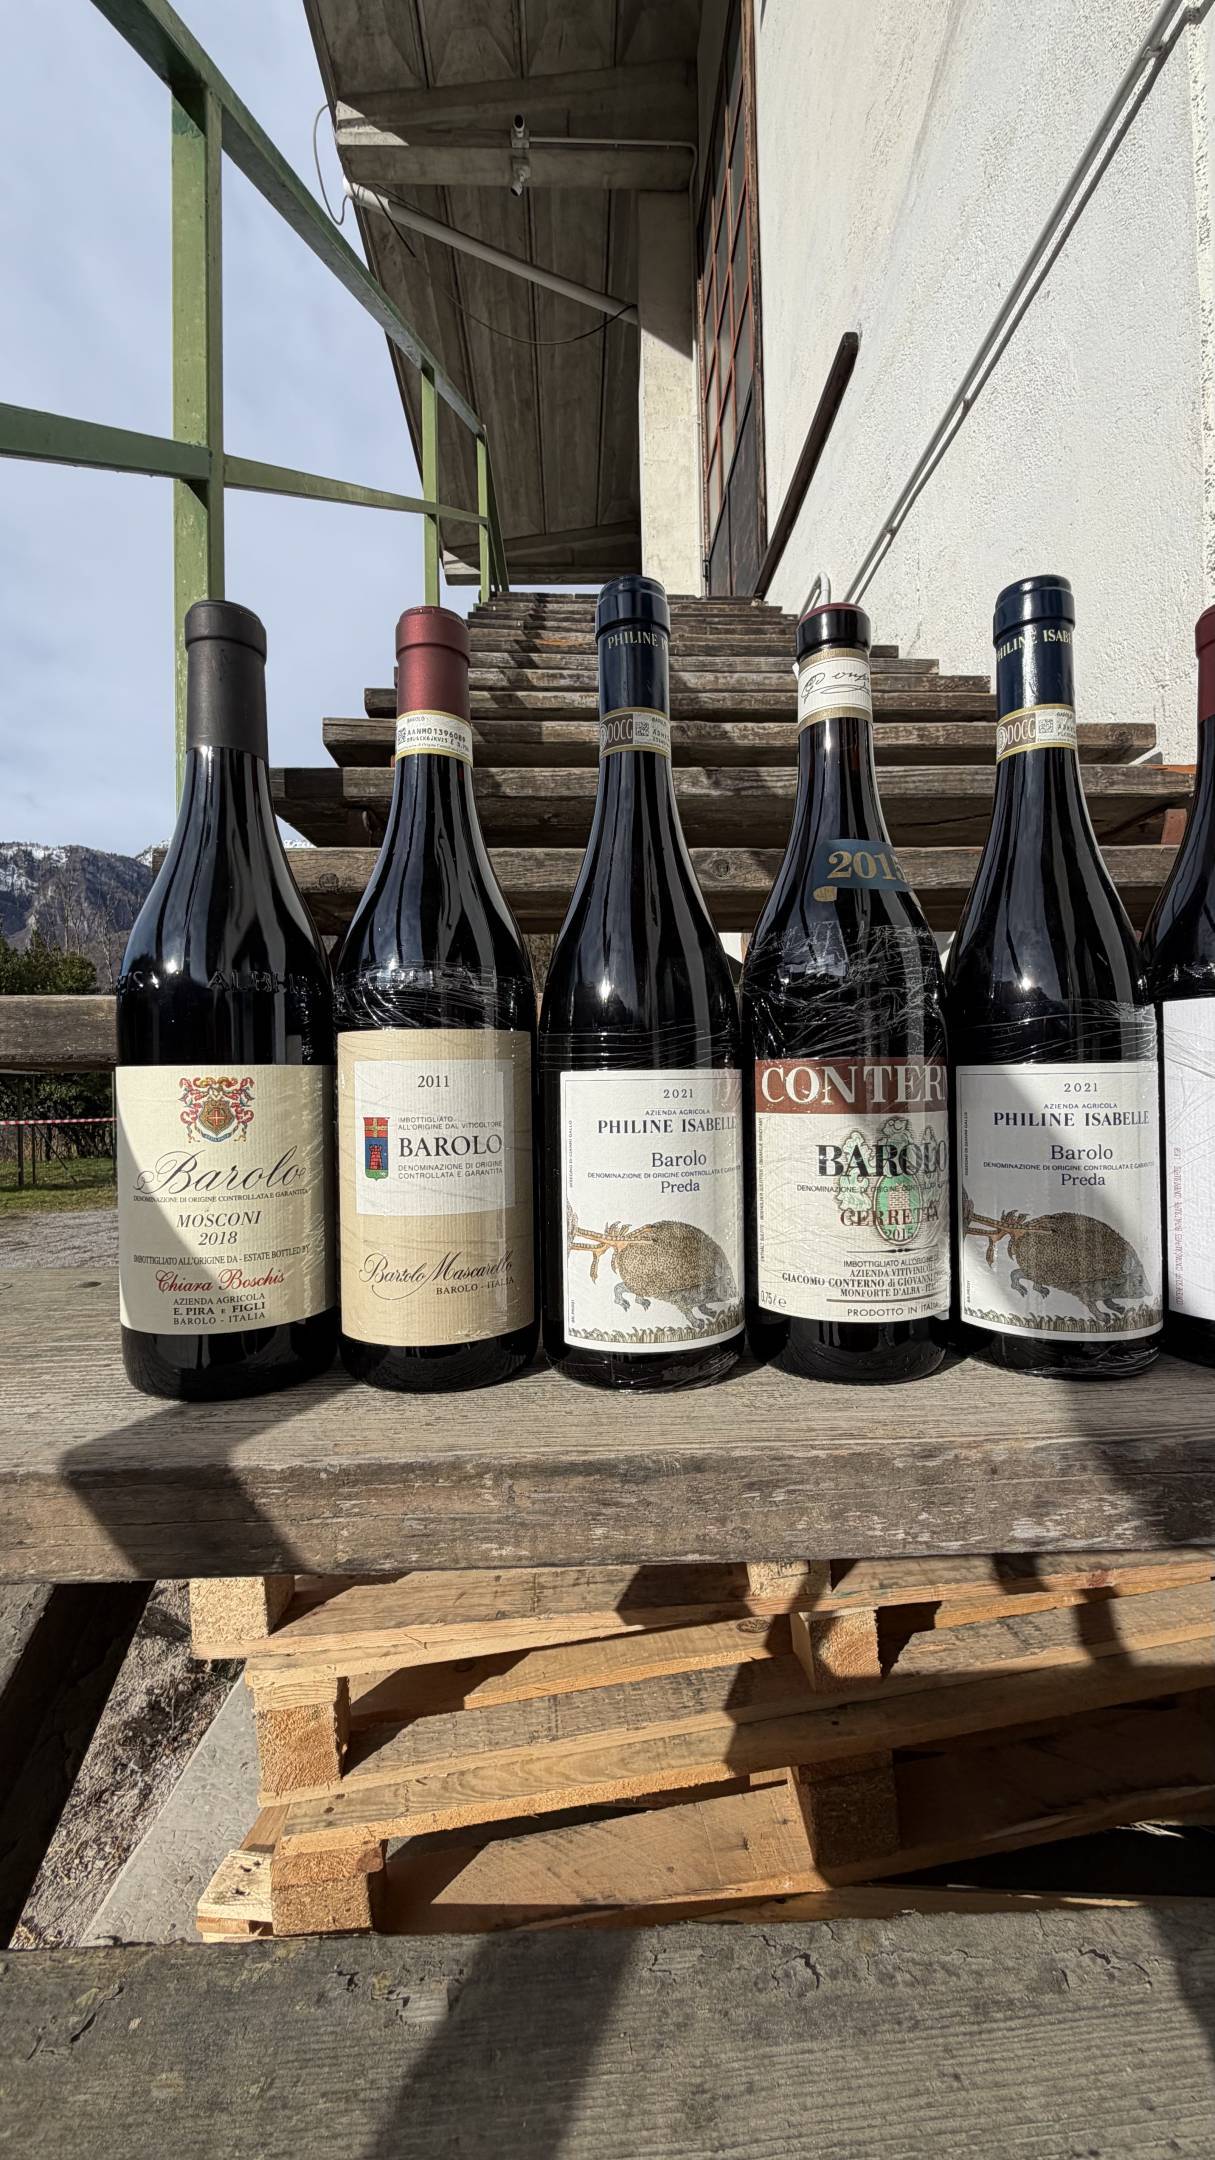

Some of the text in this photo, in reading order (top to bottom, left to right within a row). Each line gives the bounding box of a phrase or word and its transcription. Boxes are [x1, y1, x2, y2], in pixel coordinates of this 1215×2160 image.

[608, 631, 659, 649] PHILINE
[1007, 718, 1036, 745] DOCG
[417, 1075, 450, 1088] 2011
[1063, 1082, 1097, 1093] 2021
[663, 1088, 693, 1099] 2021
[461, 1121, 502, 1129] VITICOLTORE
[597, 1115, 736, 1134] PHILINE ISABELLE
[993, 1110, 1150, 1127] PHILINE ISABELLE
[398, 1133, 503, 1157] BAROLO
[1050, 1143, 1113, 1160] Barolo
[398, 1163, 463, 1172] DENOMINAZIONE
[475, 1160, 503, 1168] ORIGINE
[651, 1149, 707, 1168] Barolo
[815, 1140, 947, 1177] BAROLO
[983, 1161, 1041, 1171] DENOMINAZIONE
[1083, 1163, 1129, 1171] CONTROLLATA
[133, 1145, 307, 1194] Barolo
[398, 1171, 454, 1180] CONTROLLATA
[465, 1167, 503, 1177] GARANTITA
[652, 1171, 680, 1179] ORIGINE
[660, 1178, 701, 1194] Preda
[1061, 1173, 1106, 1186] Preda
[188, 1195, 217, 1203] ORIGINE
[218, 1192, 268, 1202] CONTROLLATA
[275, 1188, 309, 1198] GARANTITA
[797, 1184, 858, 1193] DENOMINAZIONE
[176, 1210, 262, 1228] MOSCONI
[840, 1200, 940, 1227] CERRETTA
[197, 1231, 238, 1246] 2018
[884, 1228, 914, 1241] 2015
[178, 1256, 226, 1266] ALL'ORIGINE
[226, 1255, 238, 1264] DA
[243, 1252, 270, 1262] ESTATE
[271, 1246, 301, 1258] BOTTLED
[843, 1259, 899, 1268] IMBOTTIGLIATO
[358, 1250, 514, 1291] Bartolo Mascarello
[850, 1269, 889, 1278] AZIENDA
[155, 1267, 285, 1294] Chiara Boschis
[436, 1283, 479, 1295] BAROLO
[487, 1276, 515, 1289] ITALIA
[782, 1272, 825, 1286] GIACOMO
[828, 1278, 885, 1289] CONTERNO
[887, 1278, 896, 1288] di
[173, 1292, 266, 1306] AZIENDA AGRICOLA
[840, 1288, 892, 1298] MONFORTE
[893, 1286, 920, 1297] D'ALBA
[185, 1307, 215, 1316] PIRA
[232, 1302, 266, 1313] FIGLI
[847, 1308, 904, 1317] PRODOTTO
[907, 1306, 918, 1314] IN
[173, 1317, 217, 1326] BAROLO
[229, 1312, 266, 1323] ITALIA
